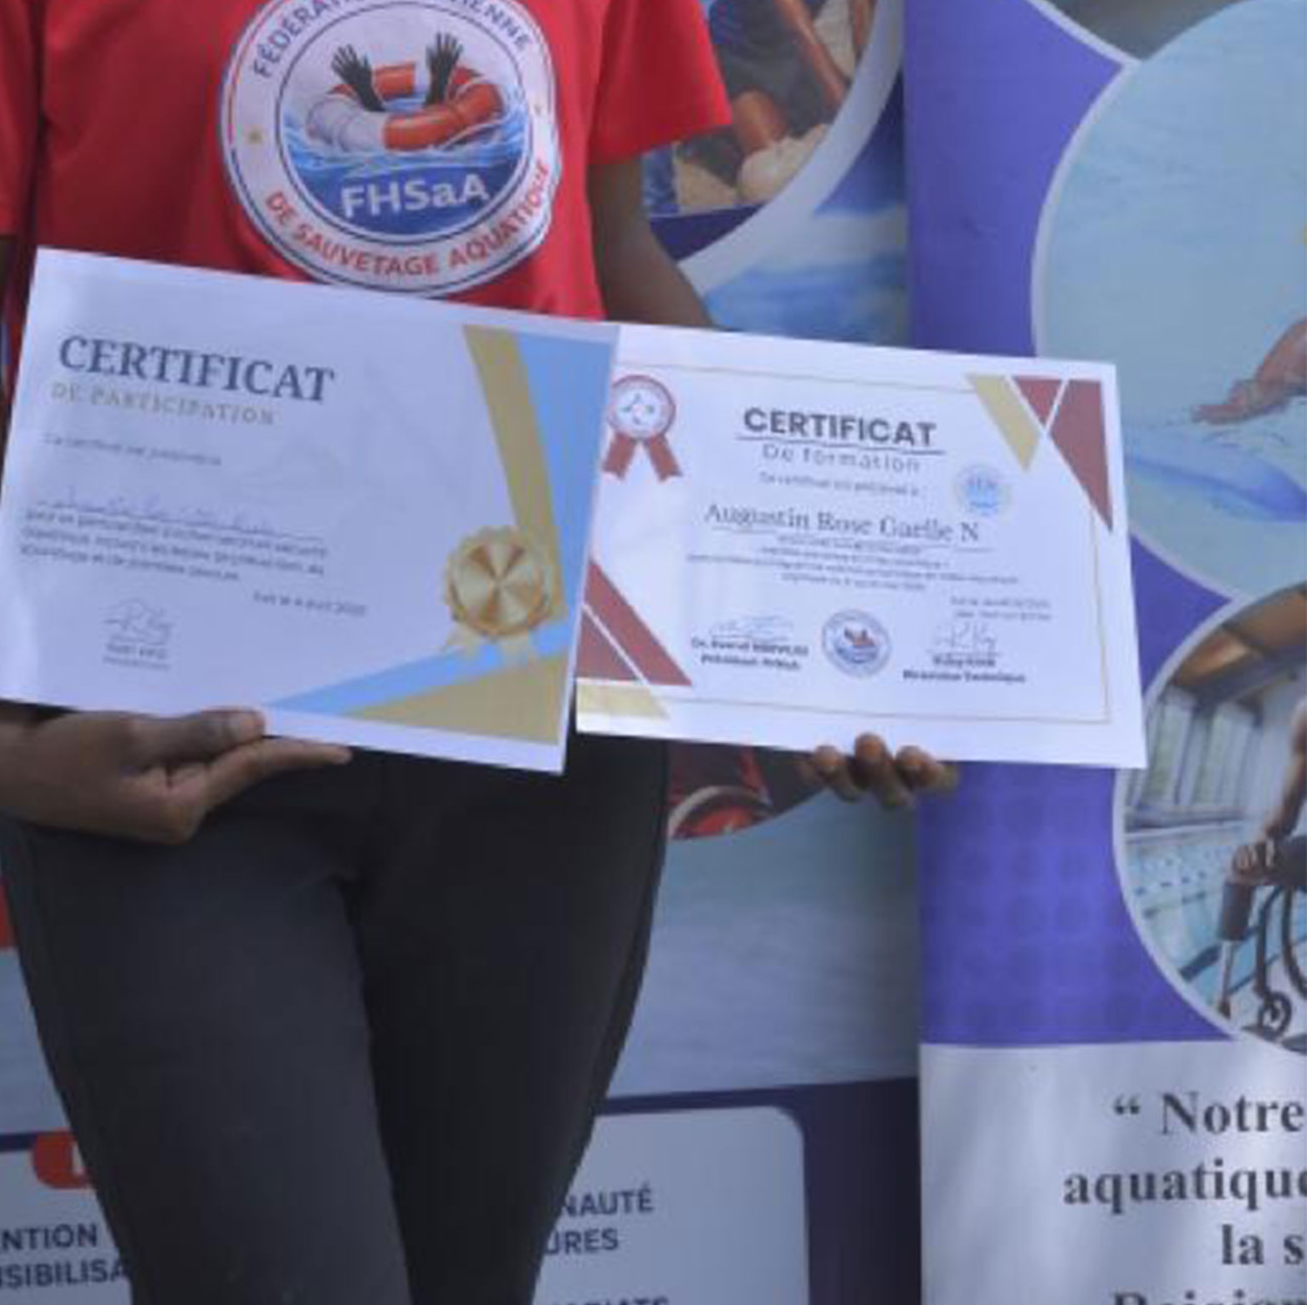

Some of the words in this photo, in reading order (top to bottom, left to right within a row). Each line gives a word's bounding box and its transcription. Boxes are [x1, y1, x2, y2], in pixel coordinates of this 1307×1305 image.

[341, 173, 490, 219] FHSaA
[266, 190, 297, 224] DE
[292, 222, 438, 276] SAUVETAGE
[58, 335, 335, 403] CERTIFICAT
[89, 384, 275, 428] PARTICIPATION
[744, 407, 937, 446] CERTIFICAT
[804, 446, 921, 474] formation
[704, 503, 810, 529] Augustin
[817, 511, 873, 535] Rose
[960, 521, 979, 542] N
[1161, 1091, 1305, 1135] Notre
[1221, 1224, 1264, 1265] la
